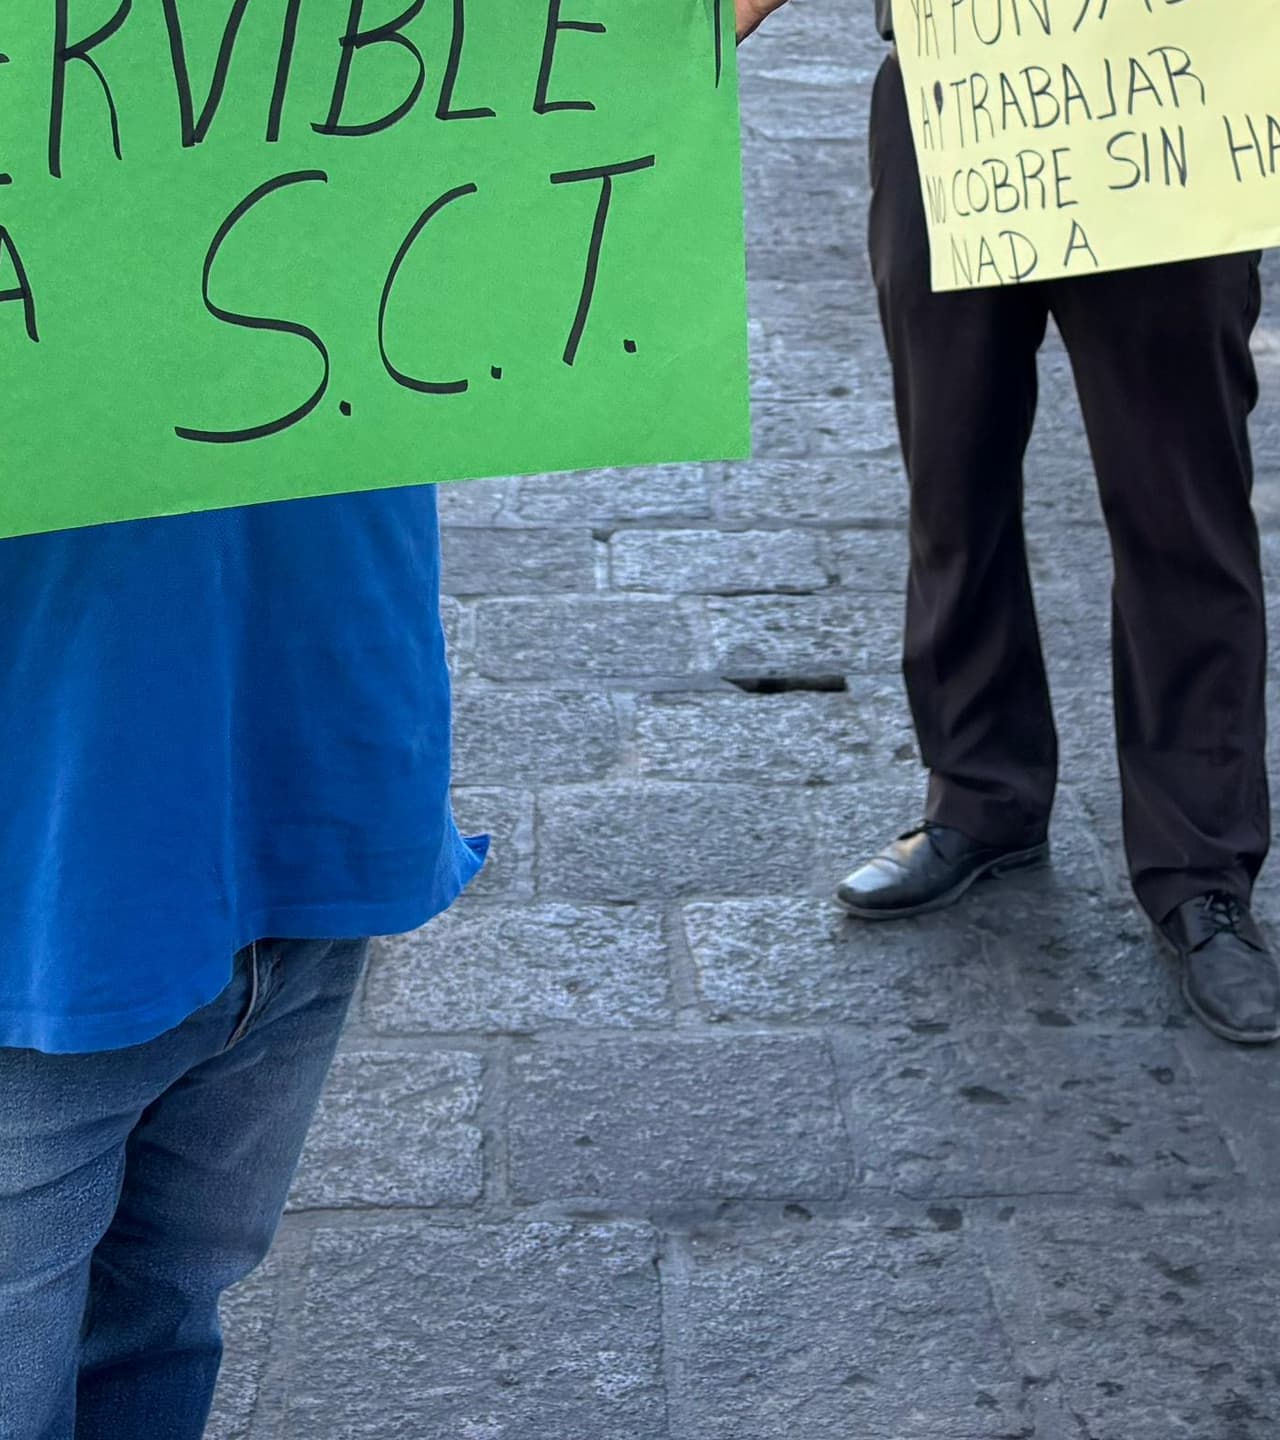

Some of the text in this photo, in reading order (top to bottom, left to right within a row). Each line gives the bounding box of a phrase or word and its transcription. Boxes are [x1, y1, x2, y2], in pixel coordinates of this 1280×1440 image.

[949, 46, 1206, 149] TRABAJAR
[925, 175, 947, 225] NO
[951, 148, 1080, 218] COBRE
[1105, 125, 1188, 190] SIN
